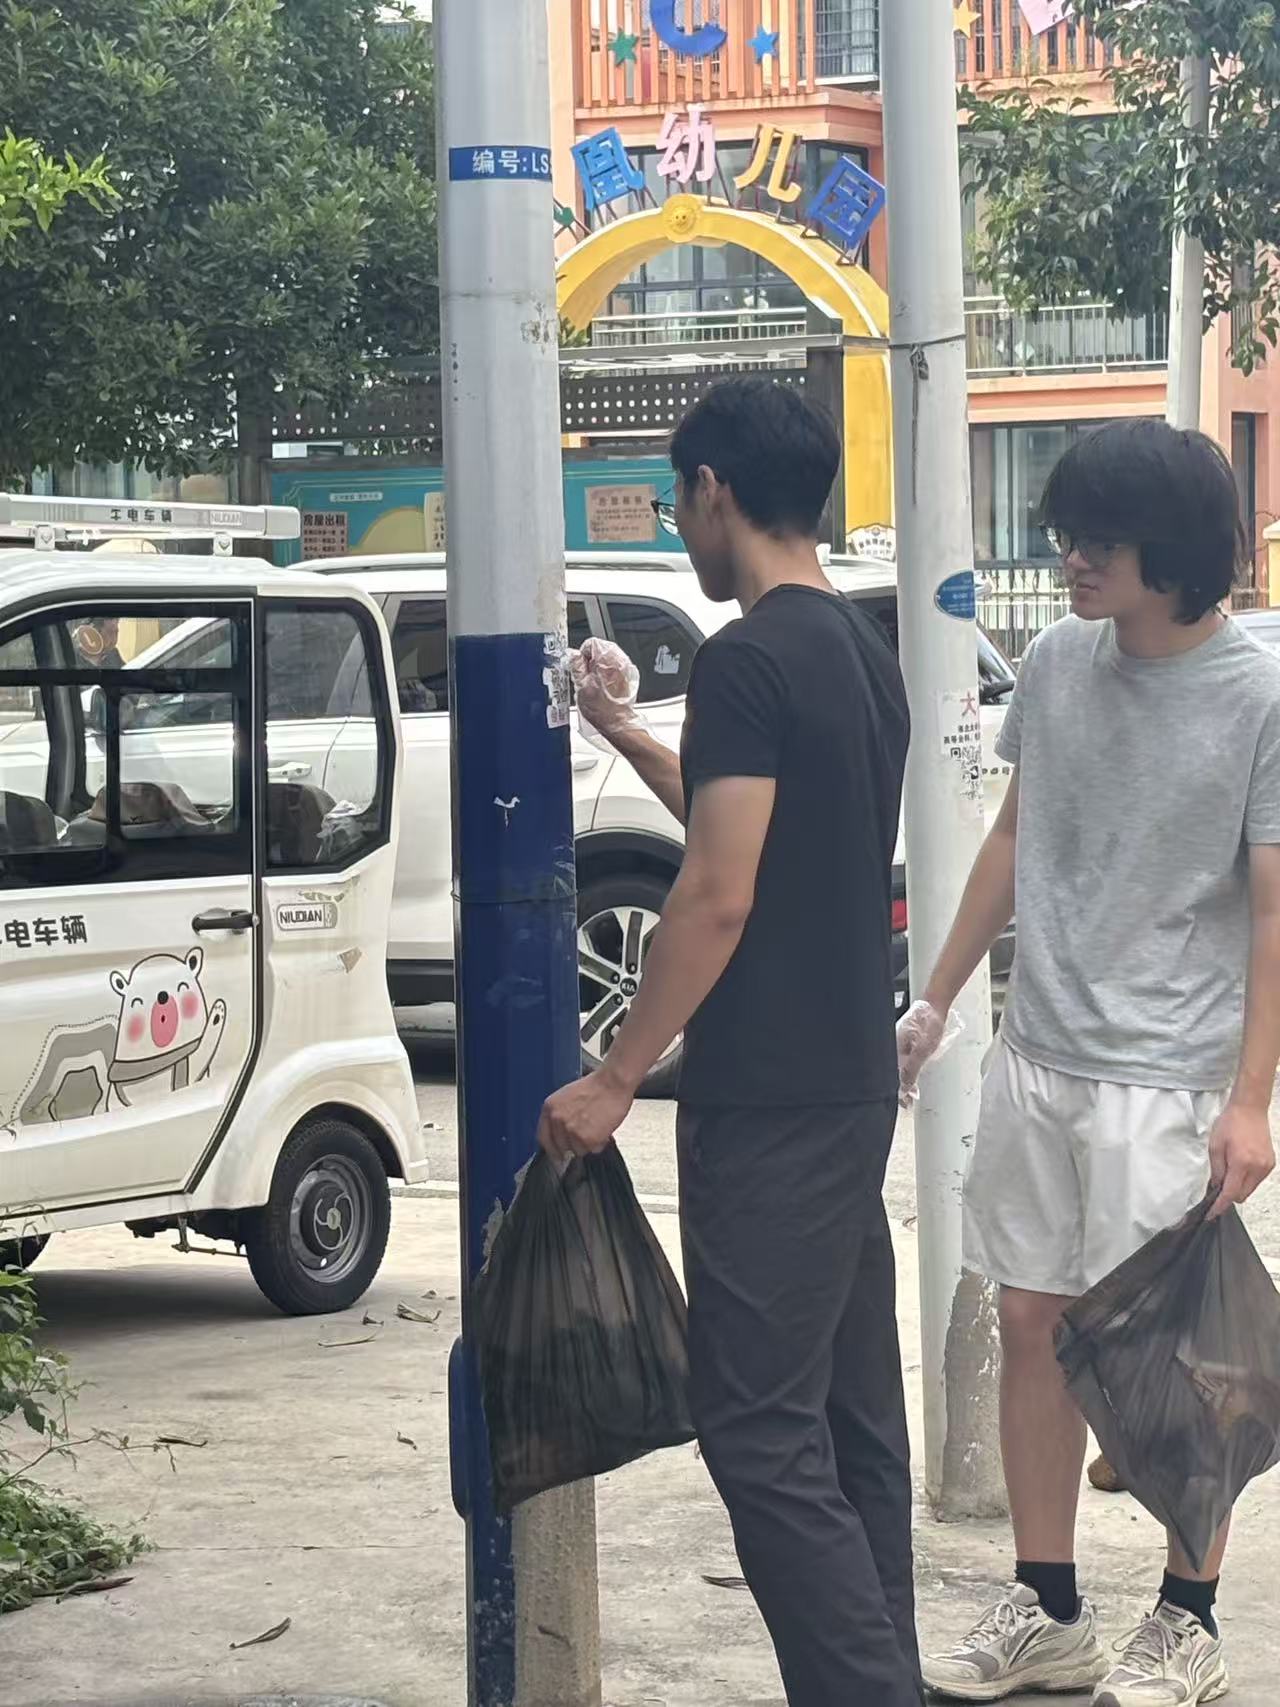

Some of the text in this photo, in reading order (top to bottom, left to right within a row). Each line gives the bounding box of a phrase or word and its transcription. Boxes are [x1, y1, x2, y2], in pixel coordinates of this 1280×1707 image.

[279, 910, 322, 924] NIUDIAN
[0, 915, 87, 948] 电车辆
